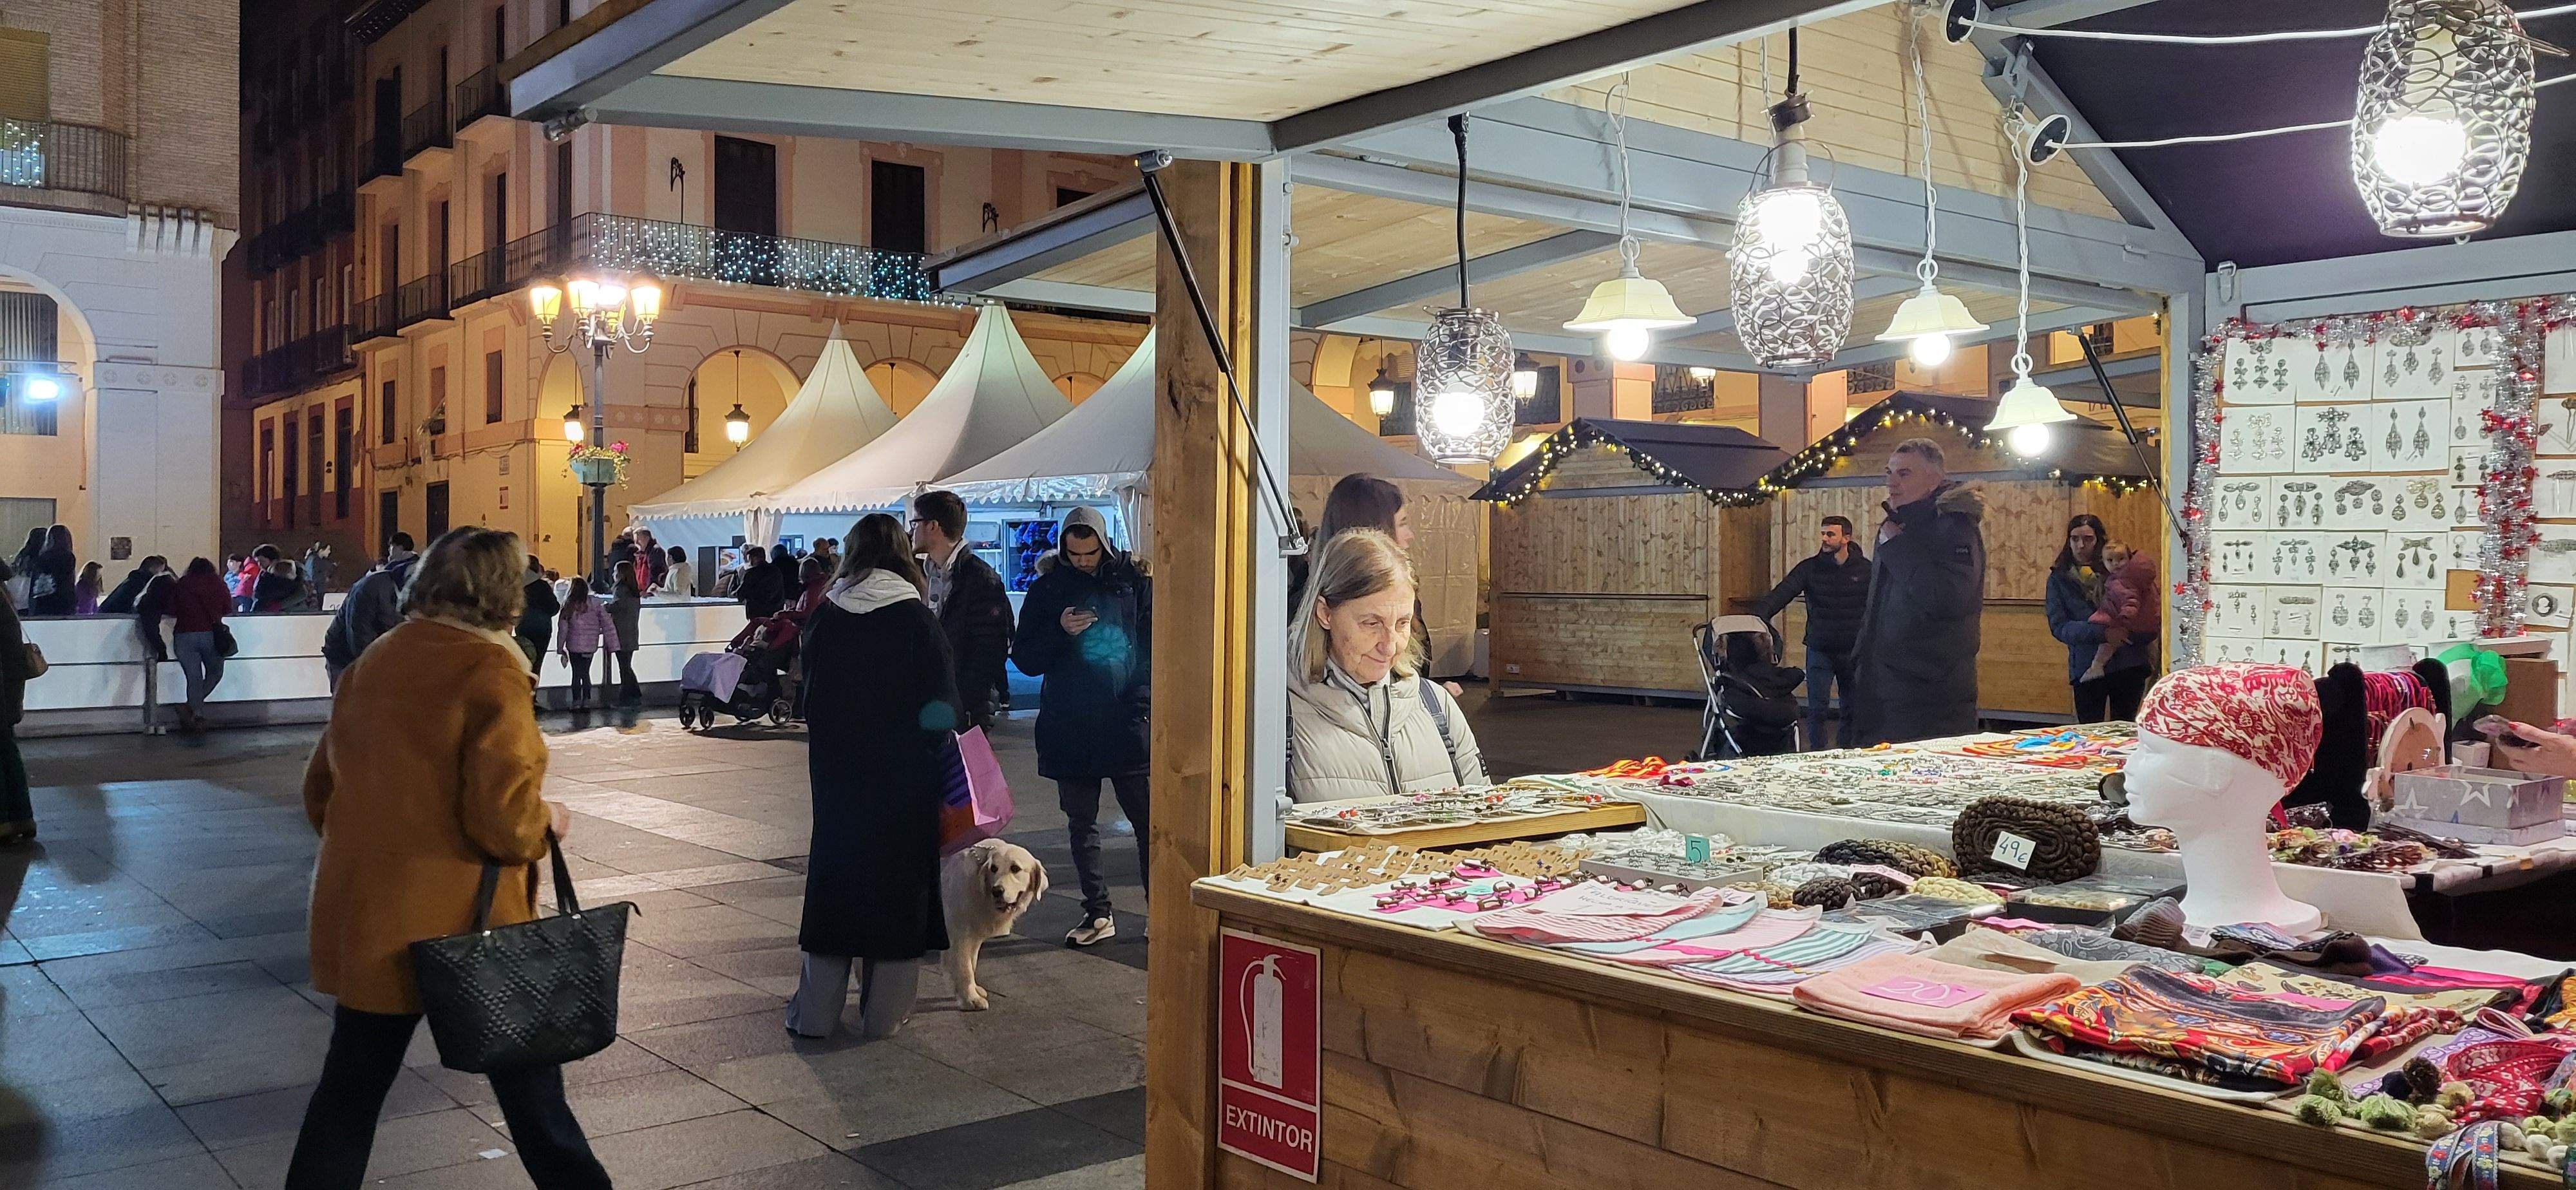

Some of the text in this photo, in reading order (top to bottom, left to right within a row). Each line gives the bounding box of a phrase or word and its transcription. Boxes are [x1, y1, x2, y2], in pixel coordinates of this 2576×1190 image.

[1689, 840, 1702, 863] 5
[1999, 836, 2028, 864] 49€
[1226, 1103, 1313, 1153] EXTINTOR
